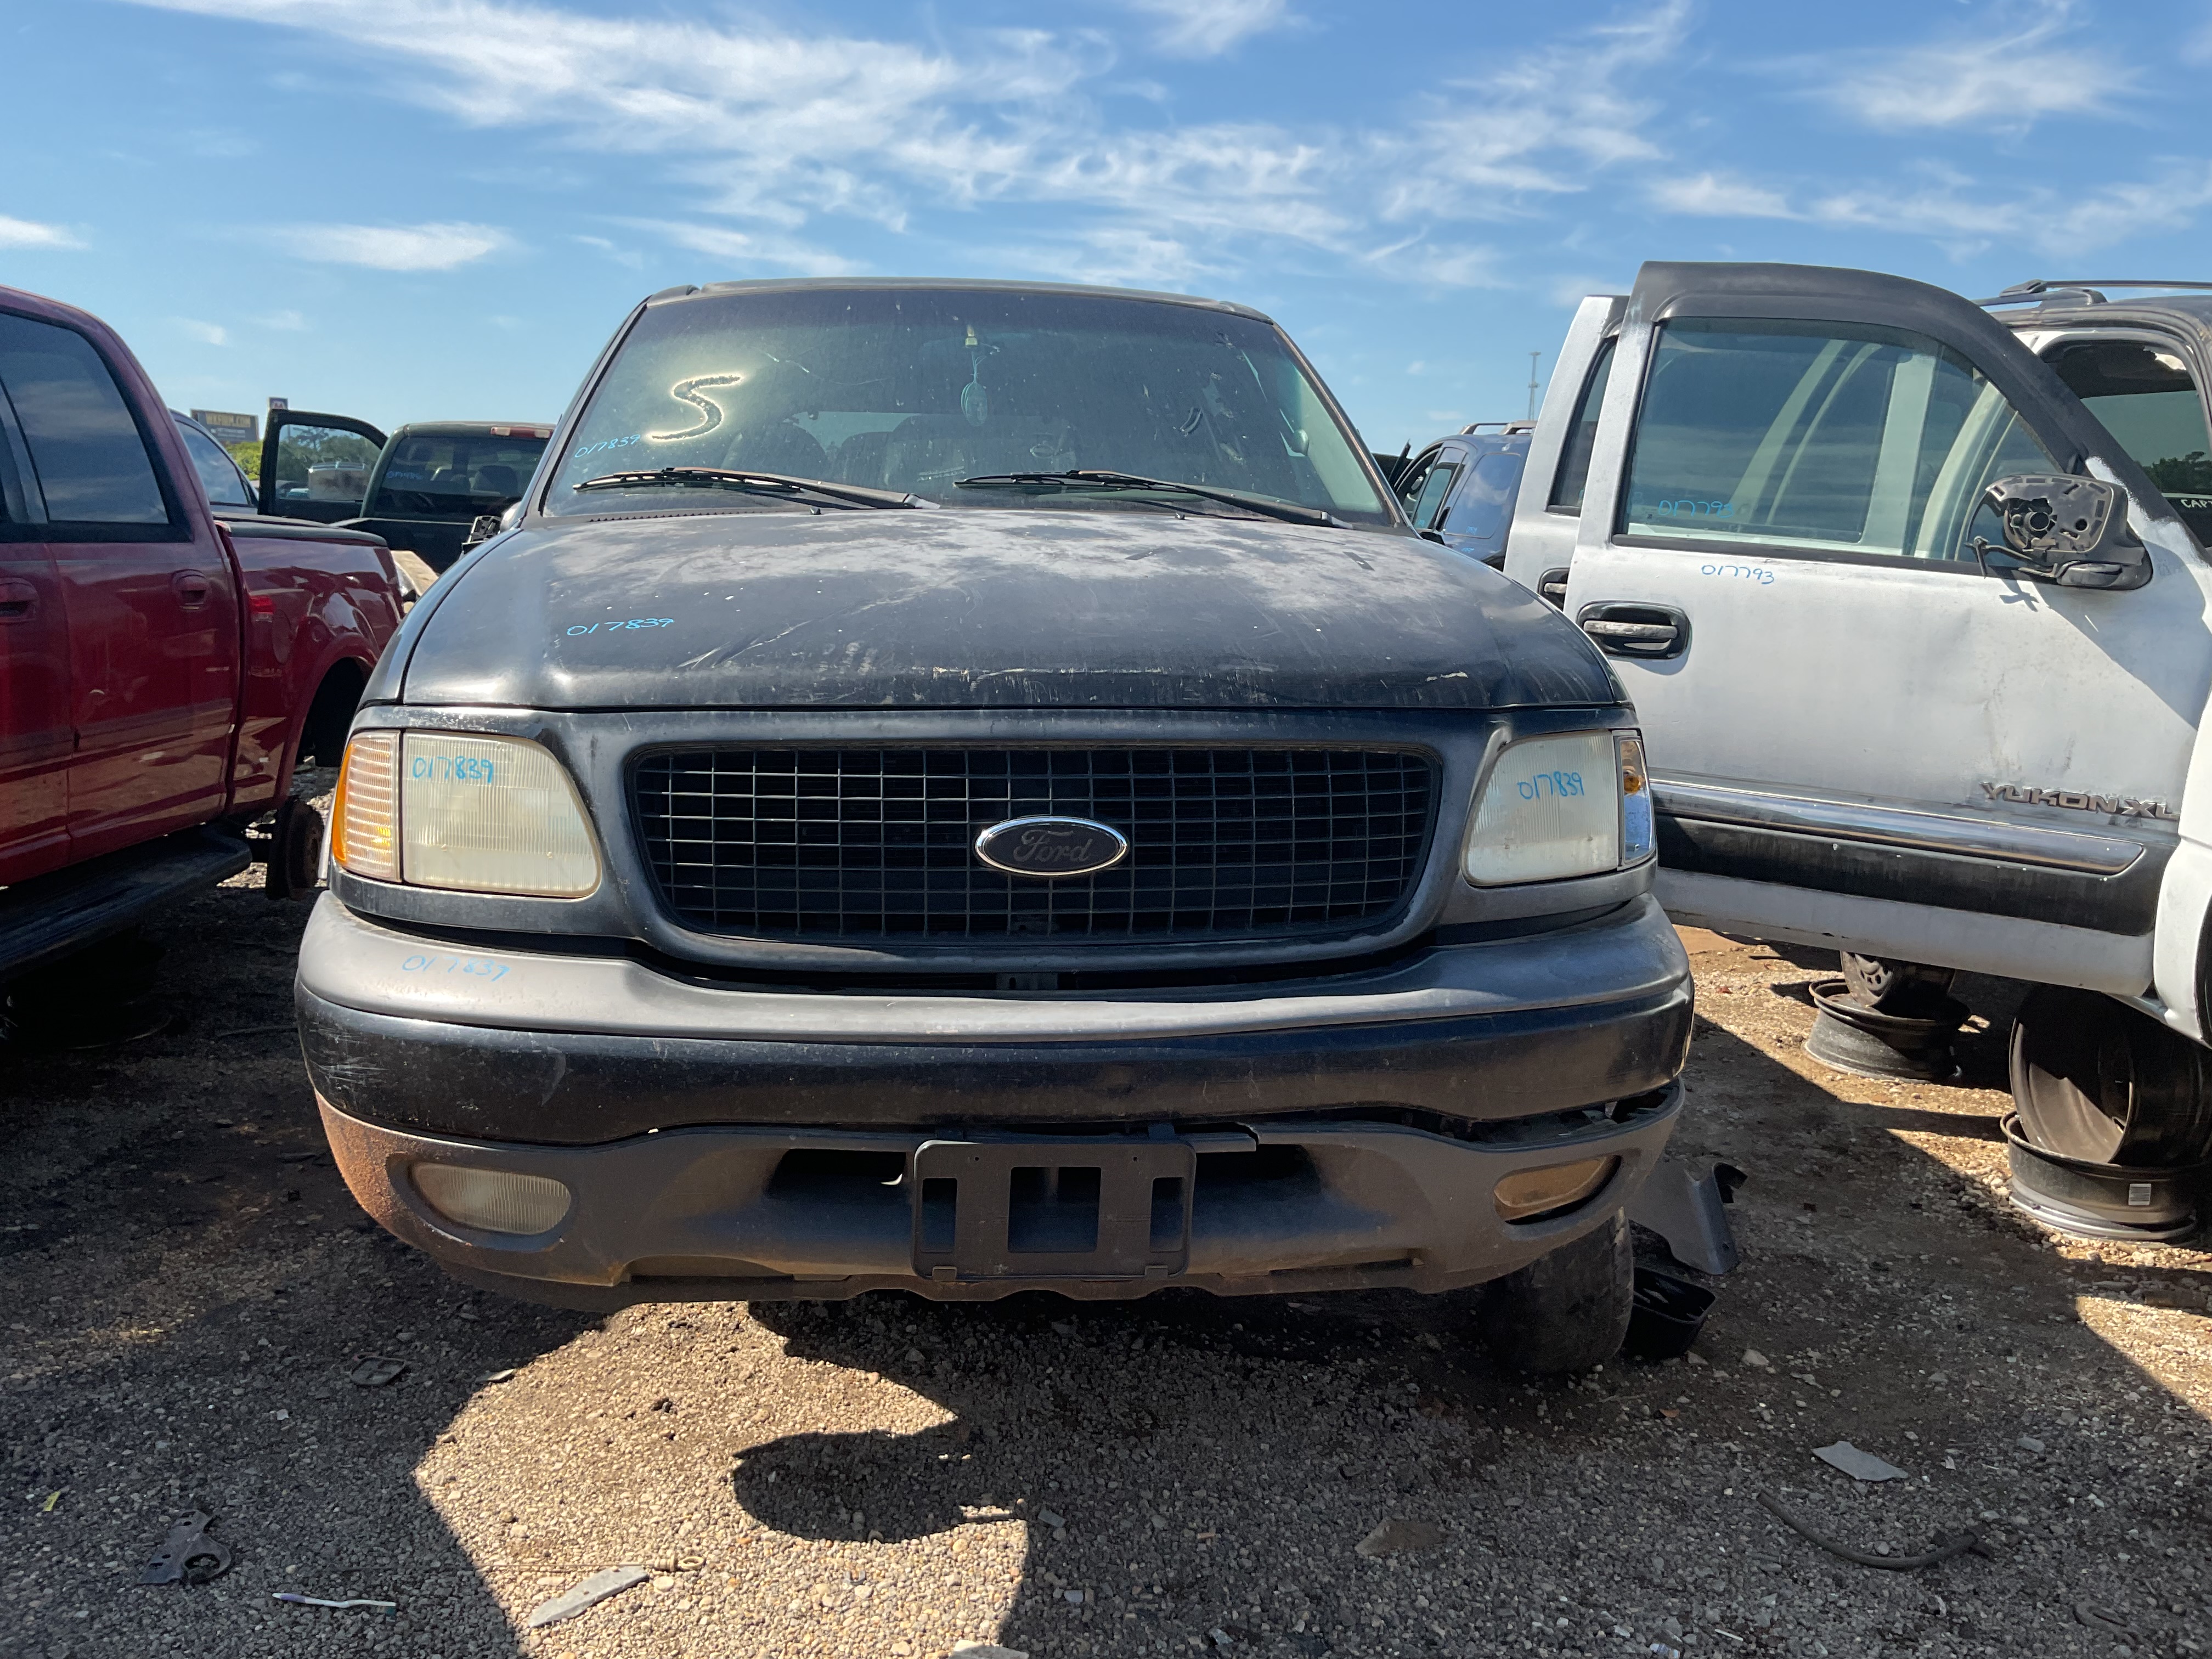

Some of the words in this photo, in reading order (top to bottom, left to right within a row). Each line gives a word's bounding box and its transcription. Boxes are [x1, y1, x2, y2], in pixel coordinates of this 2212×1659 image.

[574, 433, 641, 458] 017839
[1658, 499, 1735, 518] 017793
[1701, 564, 1775, 585] 017793
[566, 617, 675, 636] 017839
[412, 755, 495, 784] 017839
[1516, 770, 1585, 800] 017839
[1978, 781, 2119, 814] YUKON
[2121, 799, 2181, 821] XL
[1013, 829, 1093, 862] Ford
[402, 955, 511, 982] 017839
